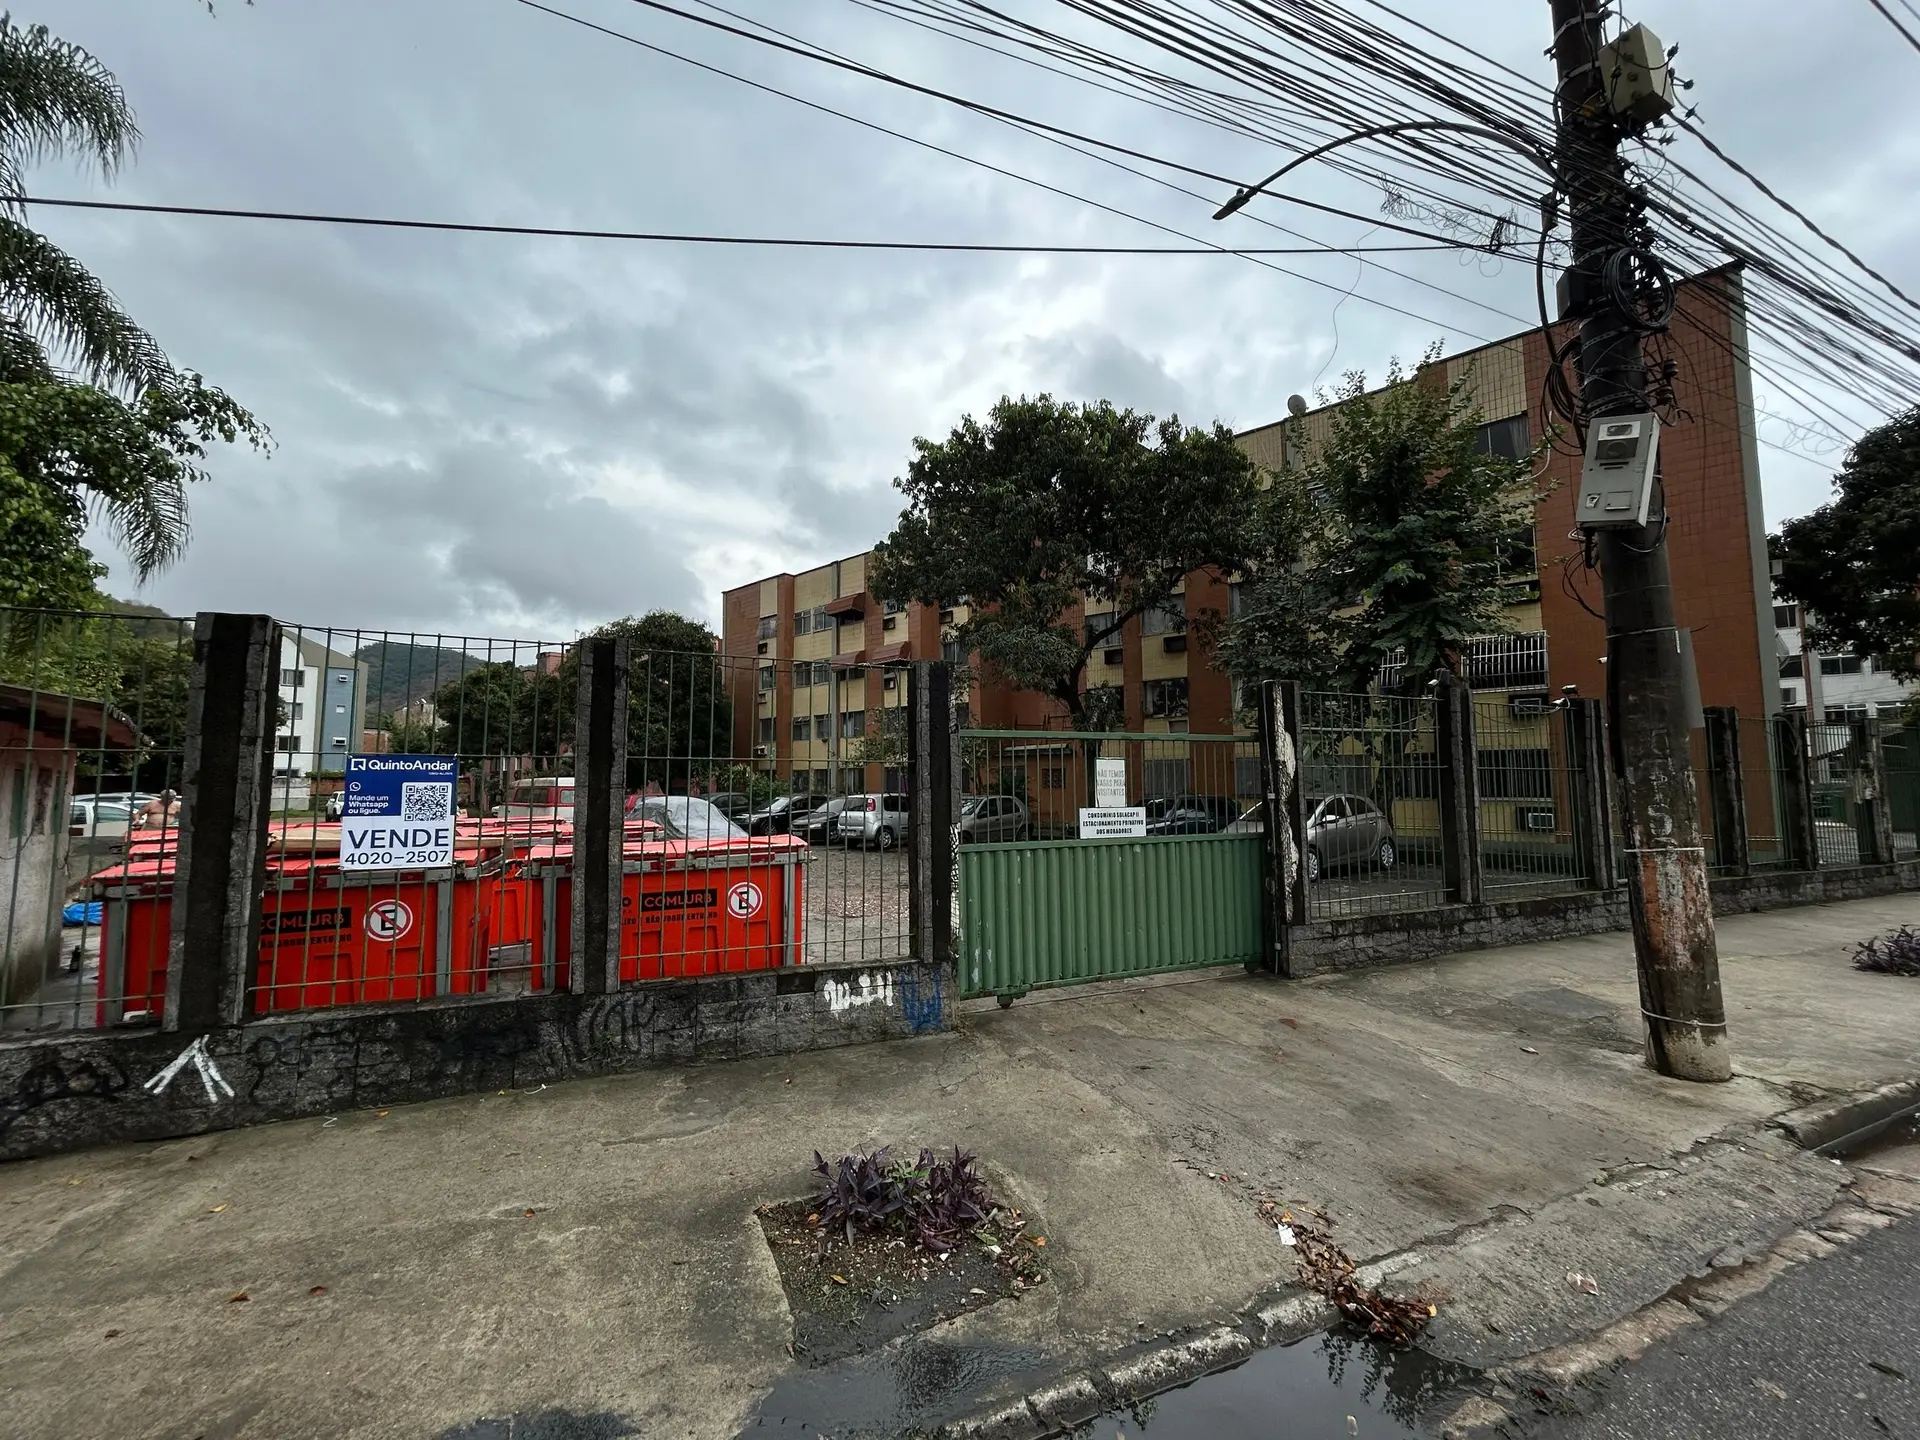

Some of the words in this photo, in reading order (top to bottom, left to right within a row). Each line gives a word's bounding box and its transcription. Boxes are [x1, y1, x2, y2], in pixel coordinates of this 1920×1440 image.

[368, 760, 453, 770] QuintoAndar
[1108, 769, 1125, 777] TEMOS
[1098, 788, 1124, 796] VISITANTES
[360, 807, 381, 815] ligue.
[347, 828, 449, 849] VENDE
[344, 850, 448, 865] 4020-2507
[644, 893, 712, 908] COMLURB
